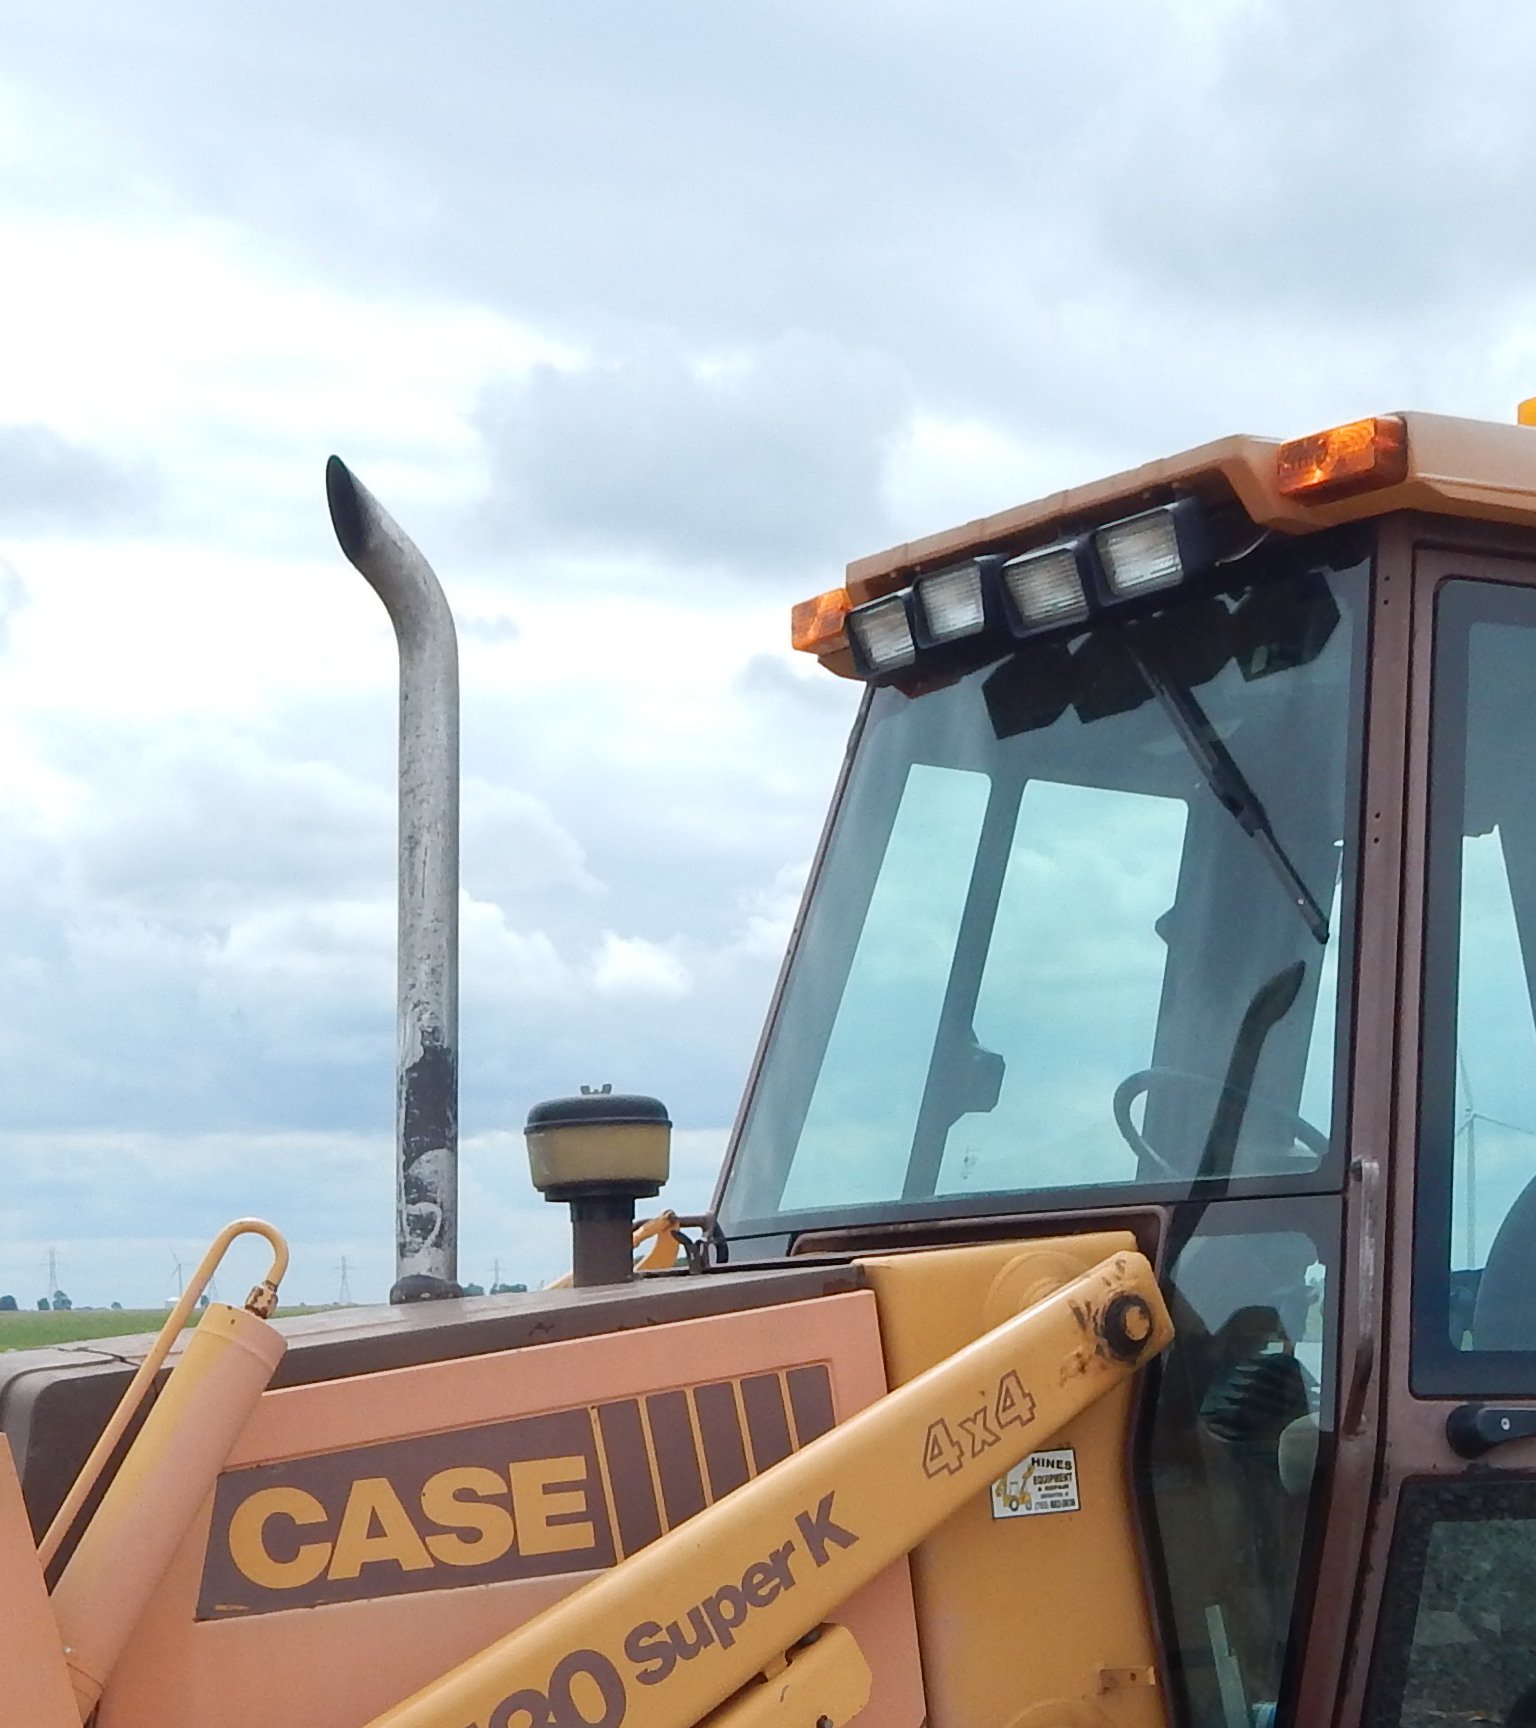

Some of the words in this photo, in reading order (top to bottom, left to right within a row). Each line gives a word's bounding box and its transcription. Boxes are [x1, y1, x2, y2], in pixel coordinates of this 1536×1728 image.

[922, 1369, 1036, 1479] 4x4
[1031, 1457, 1072, 1470] HINES
[1033, 1472, 1072, 1485] EQUIPMENT
[228, 1454, 596, 1592] CASE
[623, 1546, 796, 1687] Super
[795, 1489, 860, 1567] K
